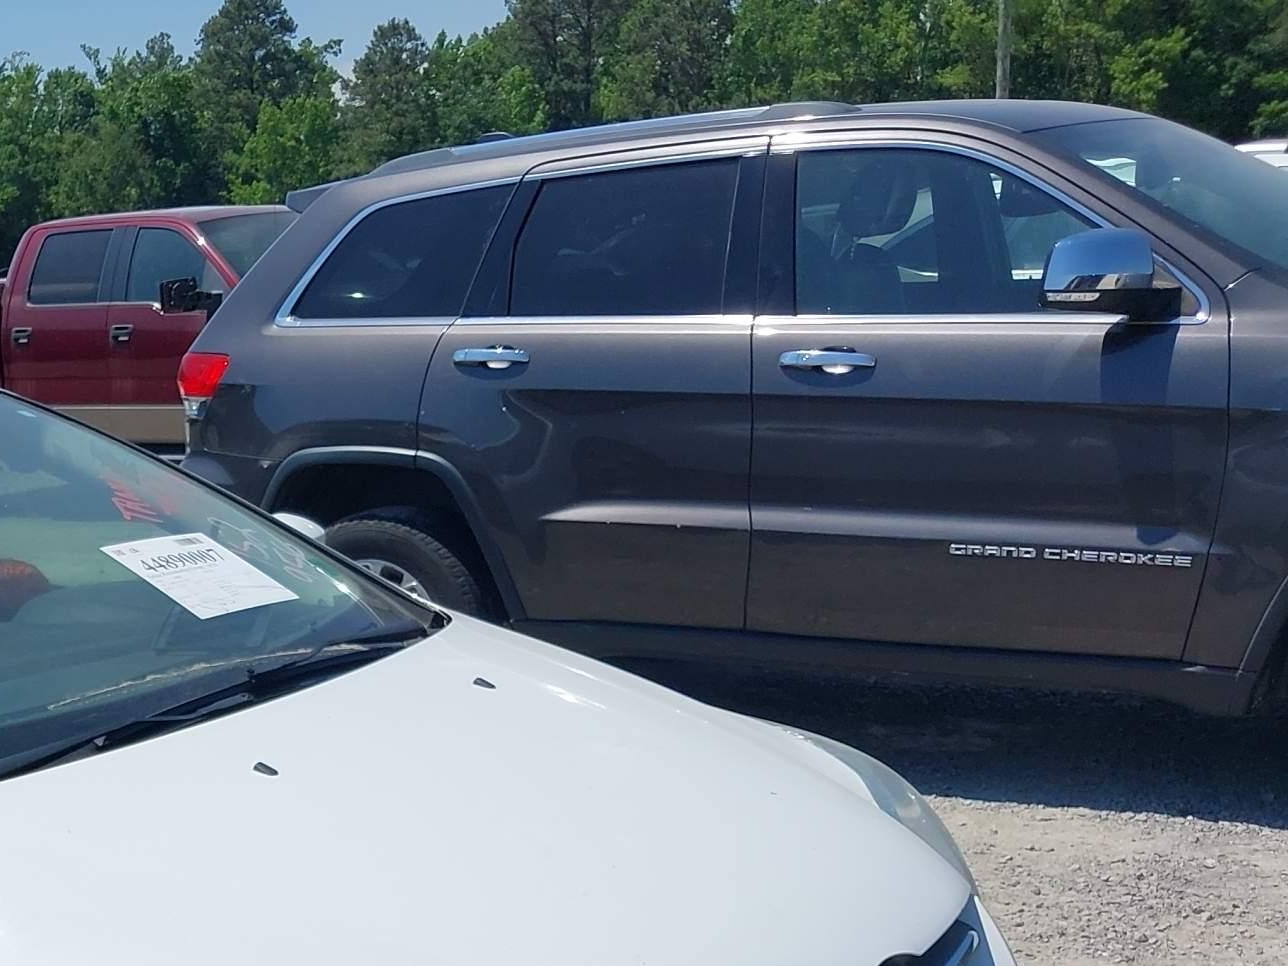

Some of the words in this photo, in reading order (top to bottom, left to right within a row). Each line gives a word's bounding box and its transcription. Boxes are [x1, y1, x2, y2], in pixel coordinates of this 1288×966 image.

[139, 548, 225, 573] 44890007
[948, 543, 1037, 558] GRAND
[1043, 548, 1193, 567] CHEROKEE
